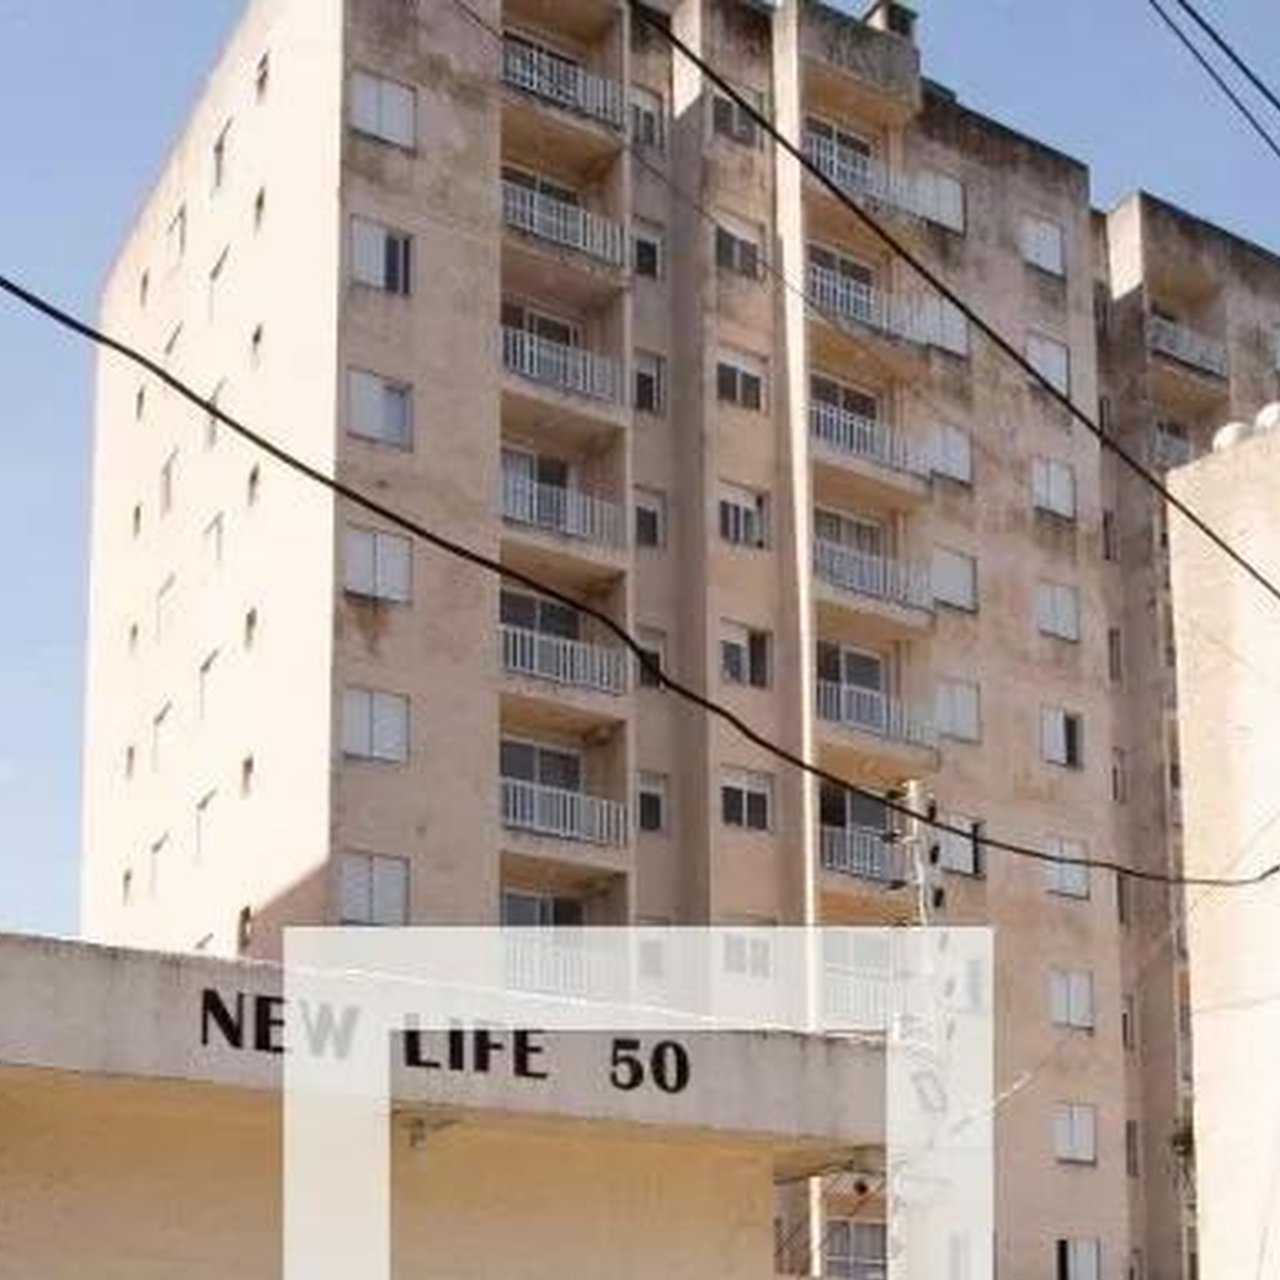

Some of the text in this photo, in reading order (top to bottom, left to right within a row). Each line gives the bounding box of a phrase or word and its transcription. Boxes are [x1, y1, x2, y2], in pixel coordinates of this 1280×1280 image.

[200, 987, 693, 1094] NEW LIFE 50
